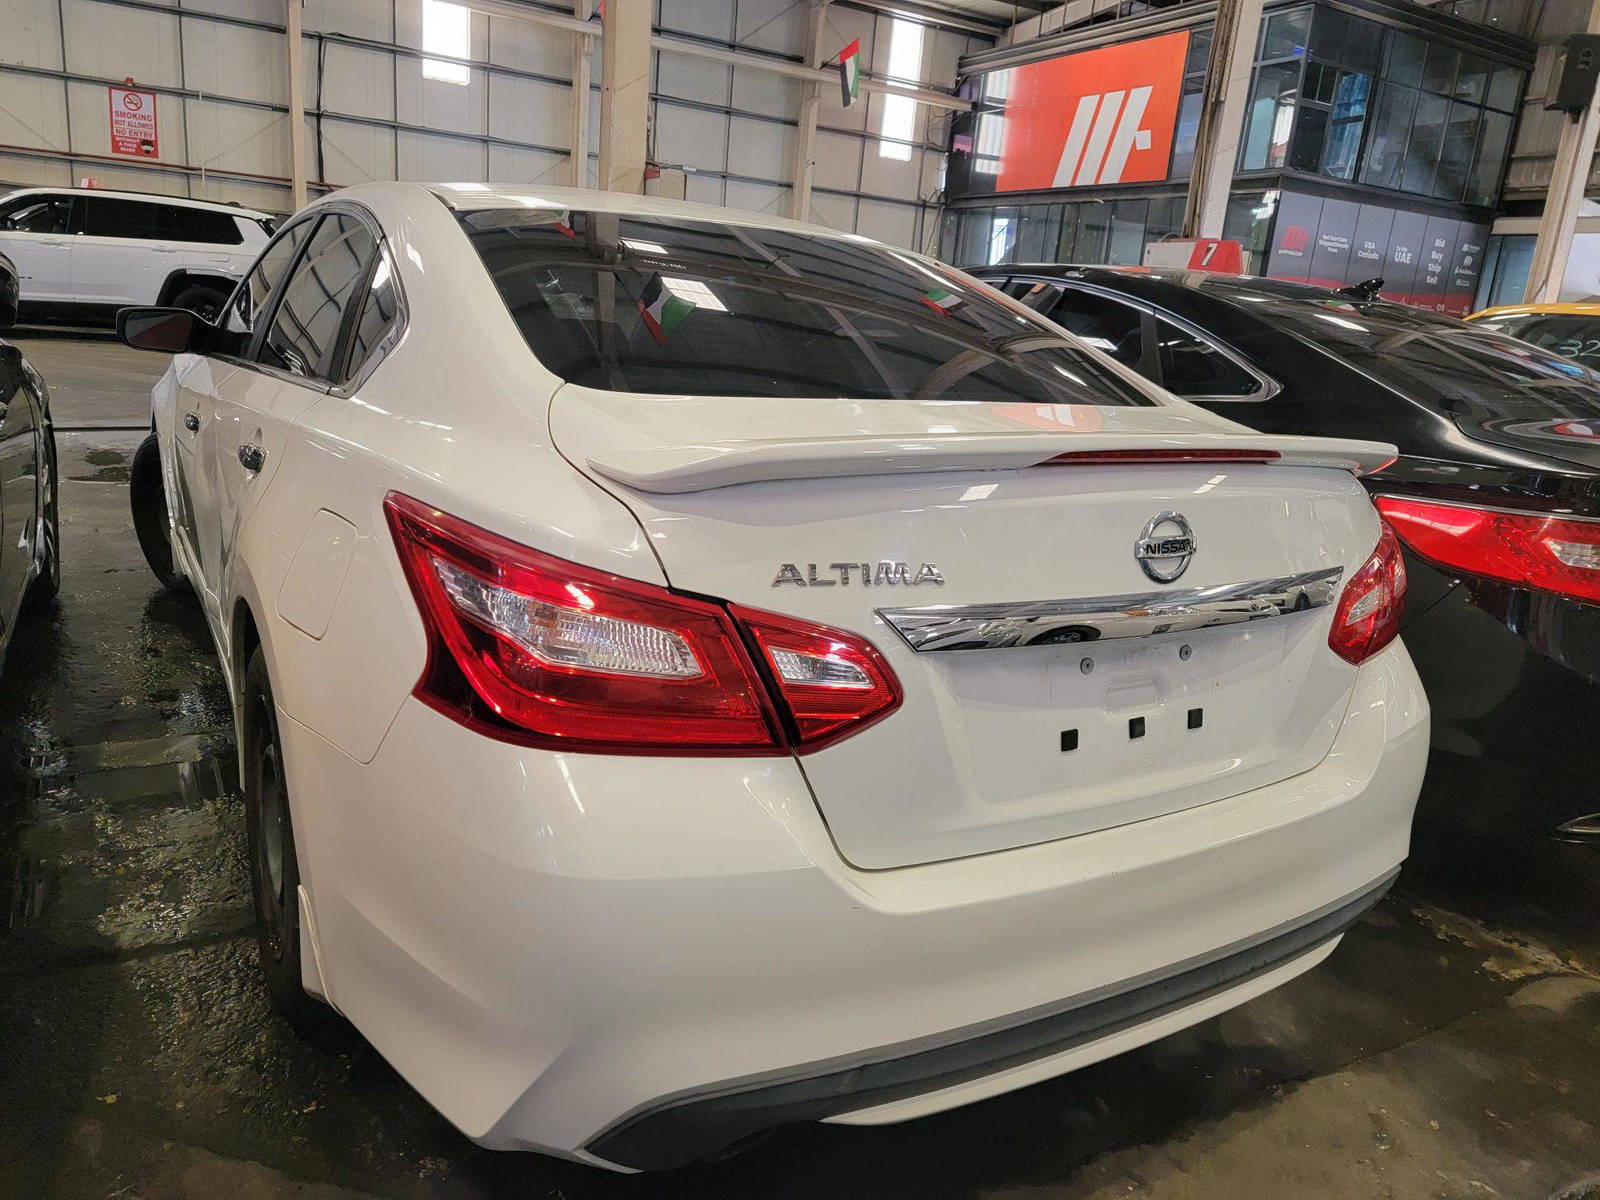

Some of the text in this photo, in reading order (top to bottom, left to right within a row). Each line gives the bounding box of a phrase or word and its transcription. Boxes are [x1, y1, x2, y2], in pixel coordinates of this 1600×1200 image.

[114, 111, 152, 121] SMOKING
[115, 119, 153, 129] NOT ALLOWED
[128, 130, 153, 139] ENTRY
[1364, 241, 1376, 249] USA
[1435, 238, 1446, 248] Bid
[1201, 243, 1218, 267] 7
[1357, 250, 1379, 260] Canada
[1394, 251, 1413, 264] UAE
[1431, 251, 1444, 263] Buy
[1427, 263, 1442, 275] Ship
[1425, 275, 1438, 285] Sell
[1145, 538, 1192, 555] NISSAN
[771, 559, 946, 588] ALTIMA
